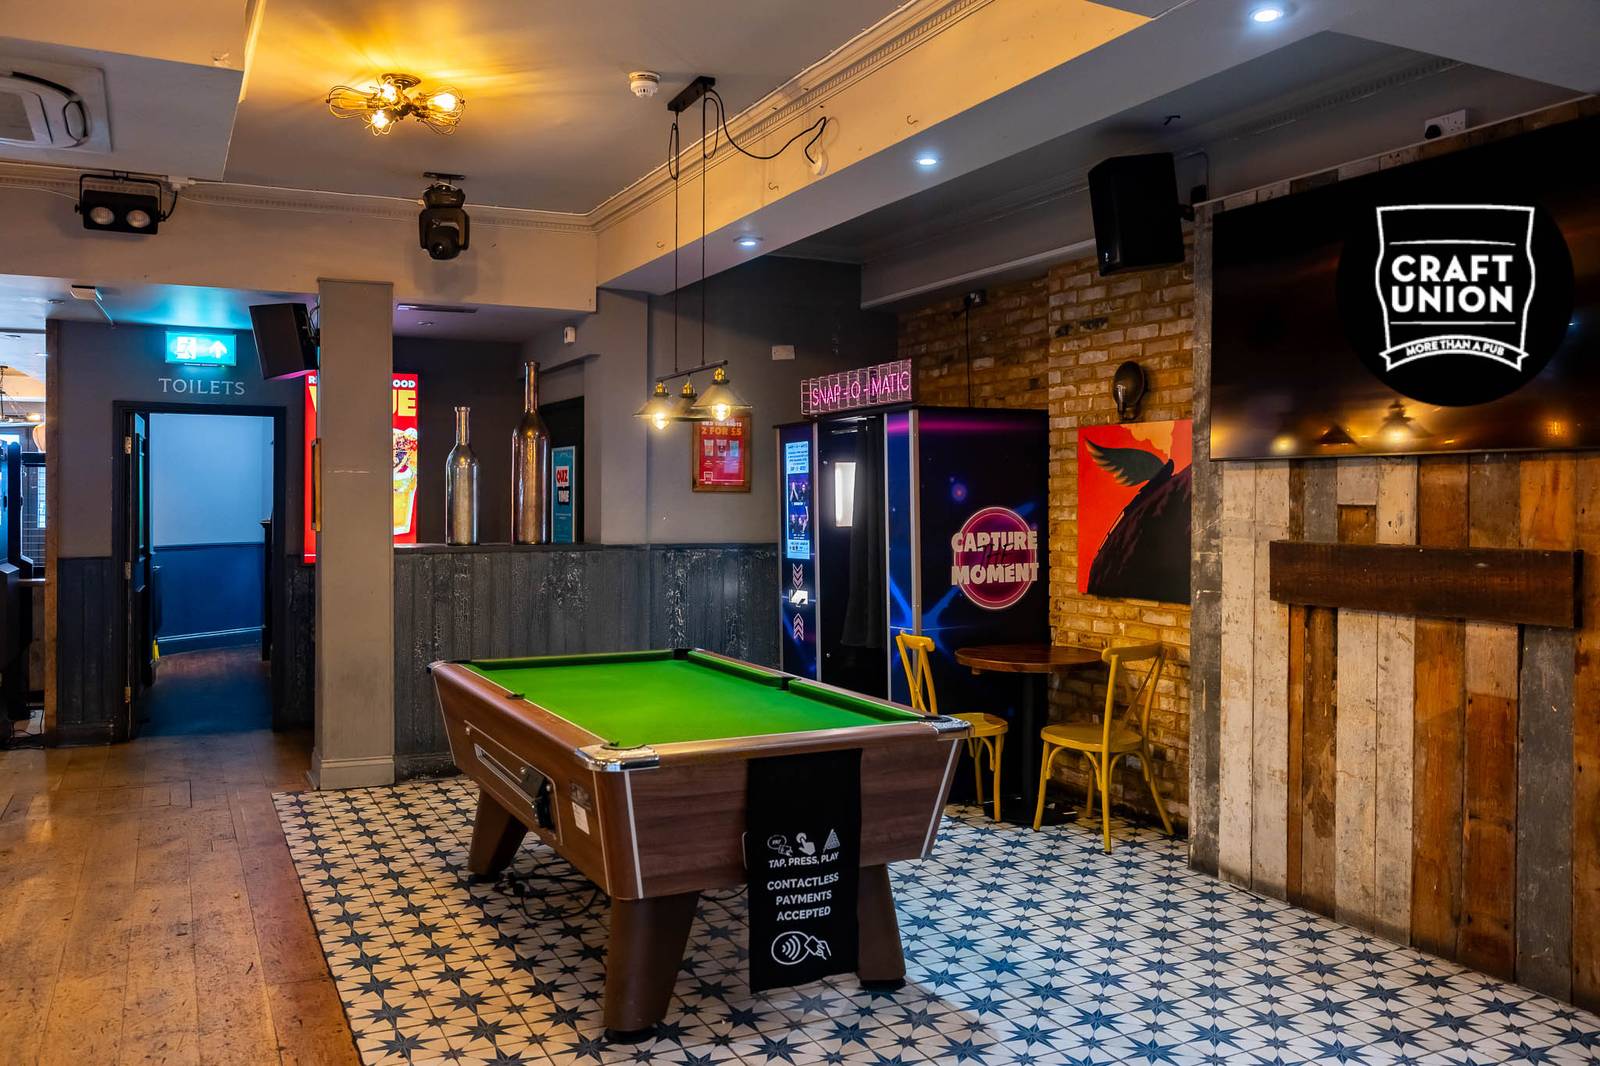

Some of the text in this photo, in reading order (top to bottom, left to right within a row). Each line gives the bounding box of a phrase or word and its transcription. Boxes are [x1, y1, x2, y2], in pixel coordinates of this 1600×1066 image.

[158, 377, 246, 396] TOILETS
[392, 379, 416, 388] OOD
[557, 469, 568, 484] QUIZ
[951, 531, 1038, 552] CAPTURE
[951, 562, 1039, 585] MOMENT
[768, 852, 839, 869] TAP, PRESS, PLAY
[767, 872, 839, 891] CONTACTLESS
[776, 890, 832, 906] PAYMENTS
[776, 906, 831, 921] ACCEPTED
